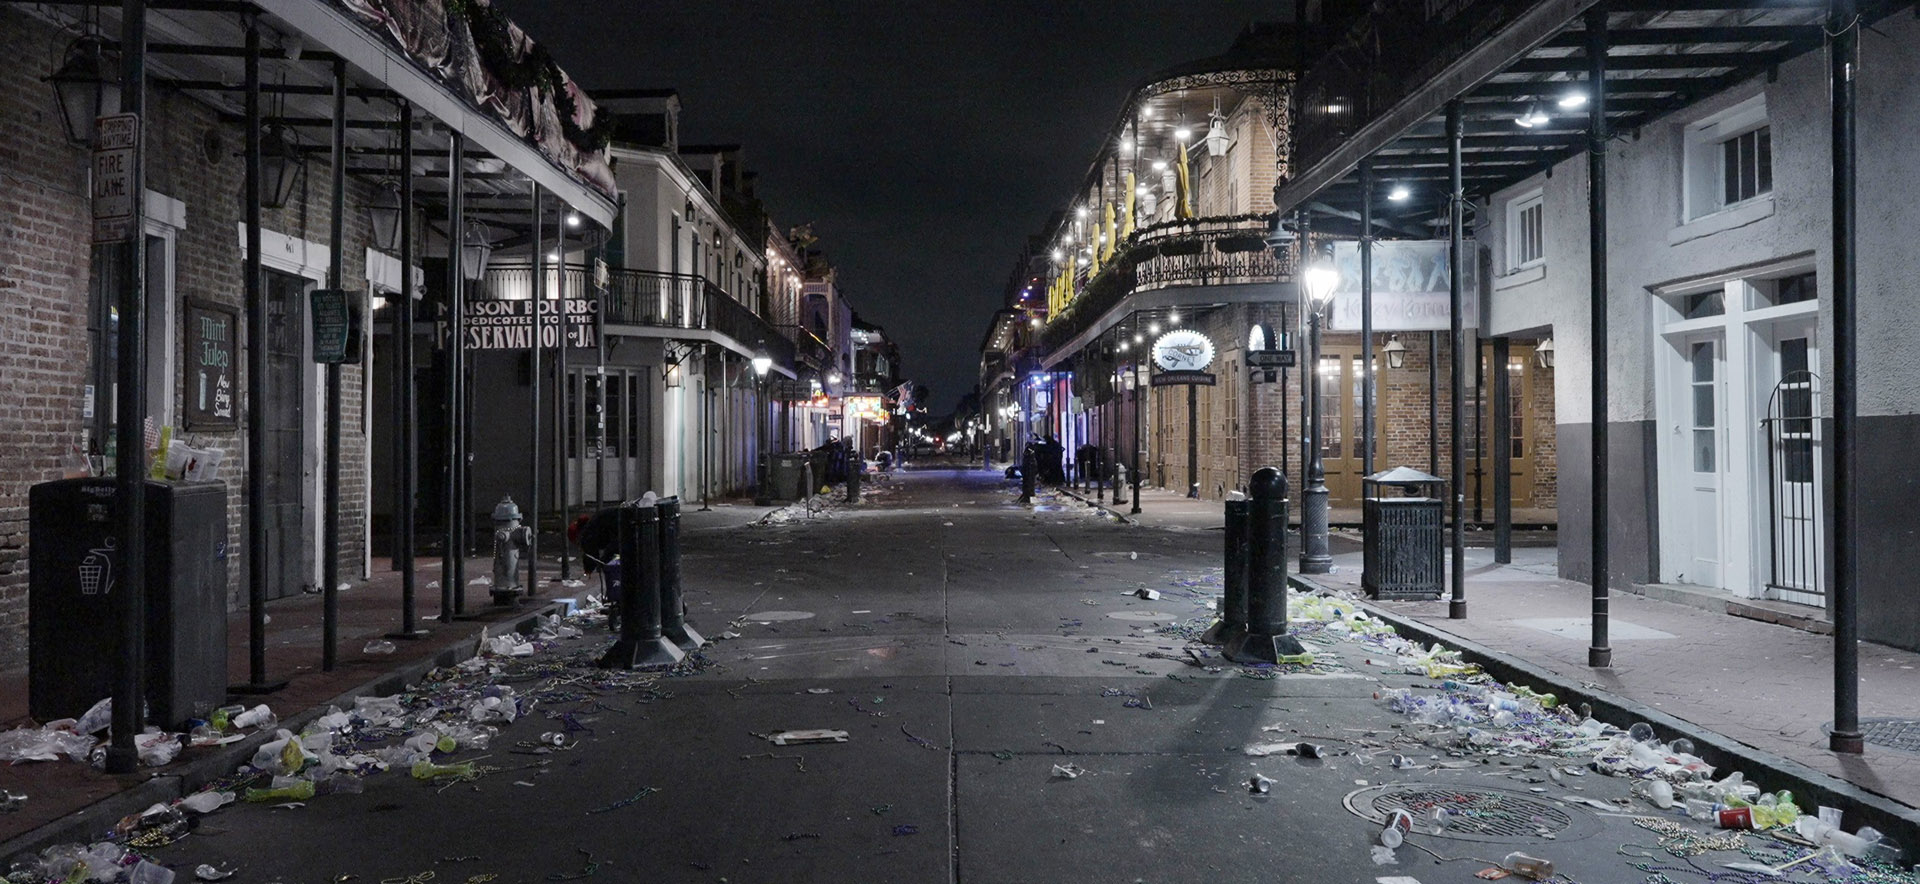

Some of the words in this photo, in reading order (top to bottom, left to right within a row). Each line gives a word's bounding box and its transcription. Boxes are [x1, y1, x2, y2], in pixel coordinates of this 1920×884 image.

[98, 154, 123, 175] FIRE
[98, 177, 126, 198] LANE
[1344, 297, 1395, 319] Krzy
[200, 317, 226, 341] Mint
[463, 315, 533, 325] DEDICATED
[542, 315, 558, 324] TO
[567, 315, 593, 324] THE
[437, 320, 569, 349] PESERVATION
[200, 341, 228, 373] Julep
[1168, 349, 1197, 362] CORNET
[1260, 354, 1274, 362] ONE
[1276, 354, 1291, 362] WAY
[1155, 376, 1166, 384] NEW
[1167, 375, 1190, 383] ORLEANS
[1192, 374, 1213, 383] CUISINE
